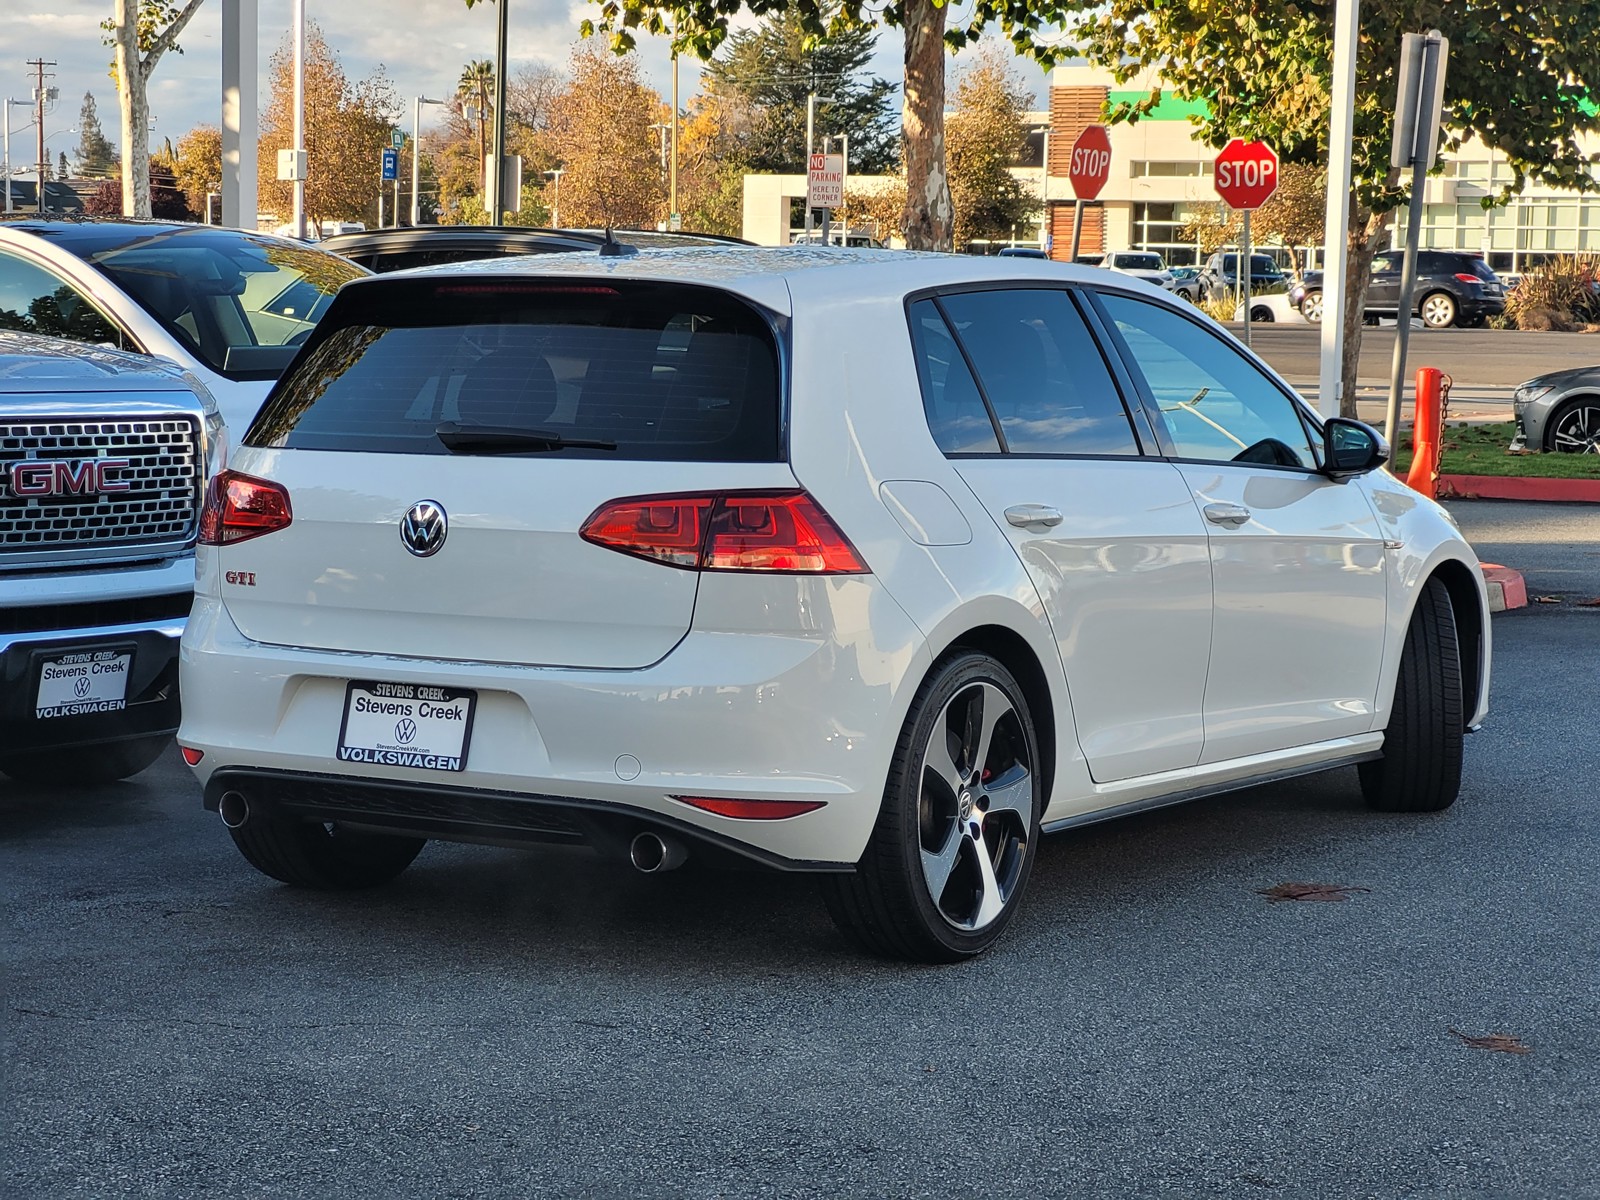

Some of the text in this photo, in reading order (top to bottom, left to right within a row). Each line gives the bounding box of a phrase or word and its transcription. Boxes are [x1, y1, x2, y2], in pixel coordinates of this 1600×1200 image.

[811, 156, 824, 169] NO
[1072, 147, 1109, 177] STOP
[811, 171, 841, 182] PARKING
[1217, 159, 1274, 188] STOP
[812, 185, 829, 193] HERE
[11, 458, 131, 497] GMC
[225, 570, 257, 587] GTI
[62, 651, 114, 664] STEVENS CREEK
[44, 661, 125, 679] Stevens Creek
[376, 683, 445, 701] STEVENS CREEK
[35, 699, 126, 719] VOLKSWAGEN
[355, 697, 464, 721] Stevens Creek
[376, 743, 431, 753] StevensCreekVW.com
[340, 747, 461, 771] VOLKSWAGEN
